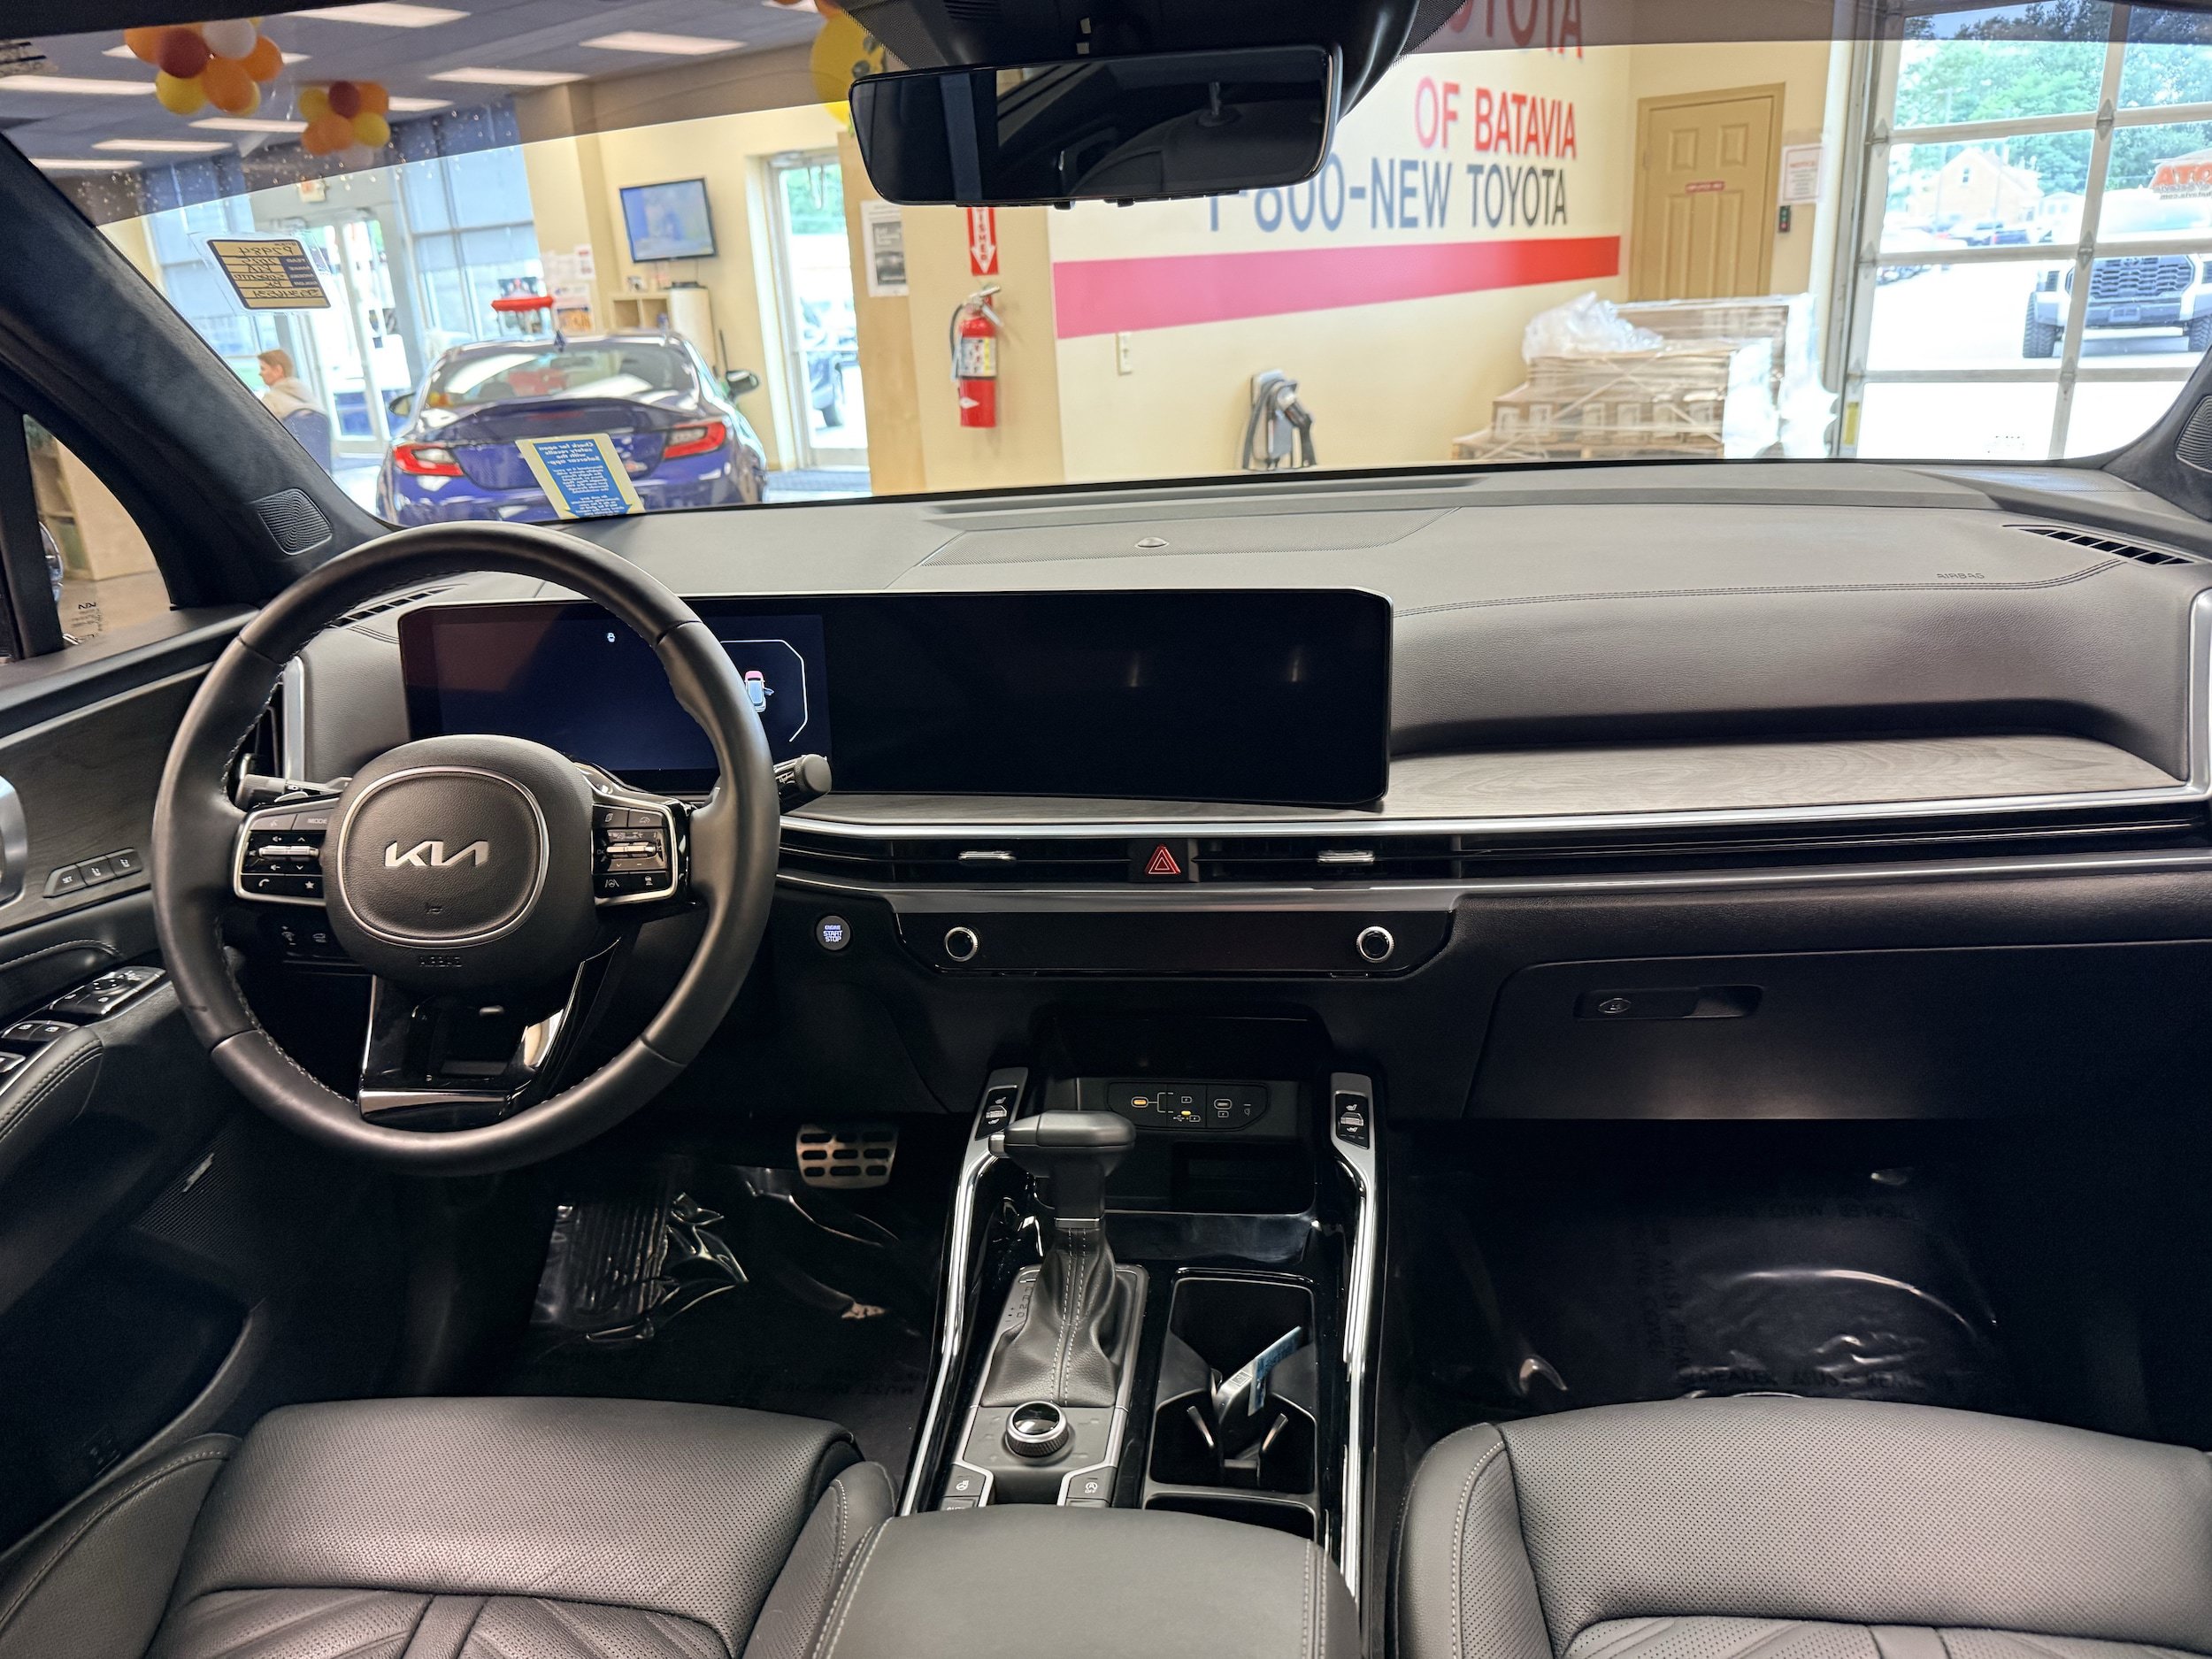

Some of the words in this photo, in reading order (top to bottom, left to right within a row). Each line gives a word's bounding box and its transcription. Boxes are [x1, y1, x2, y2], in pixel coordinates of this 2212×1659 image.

[1415, 76, 1460, 150] OF
[1475, 86, 1577, 160] BATAVIA
[1467, 163, 1568, 229] TOYOTA
[385, 840, 489, 868] KIA
